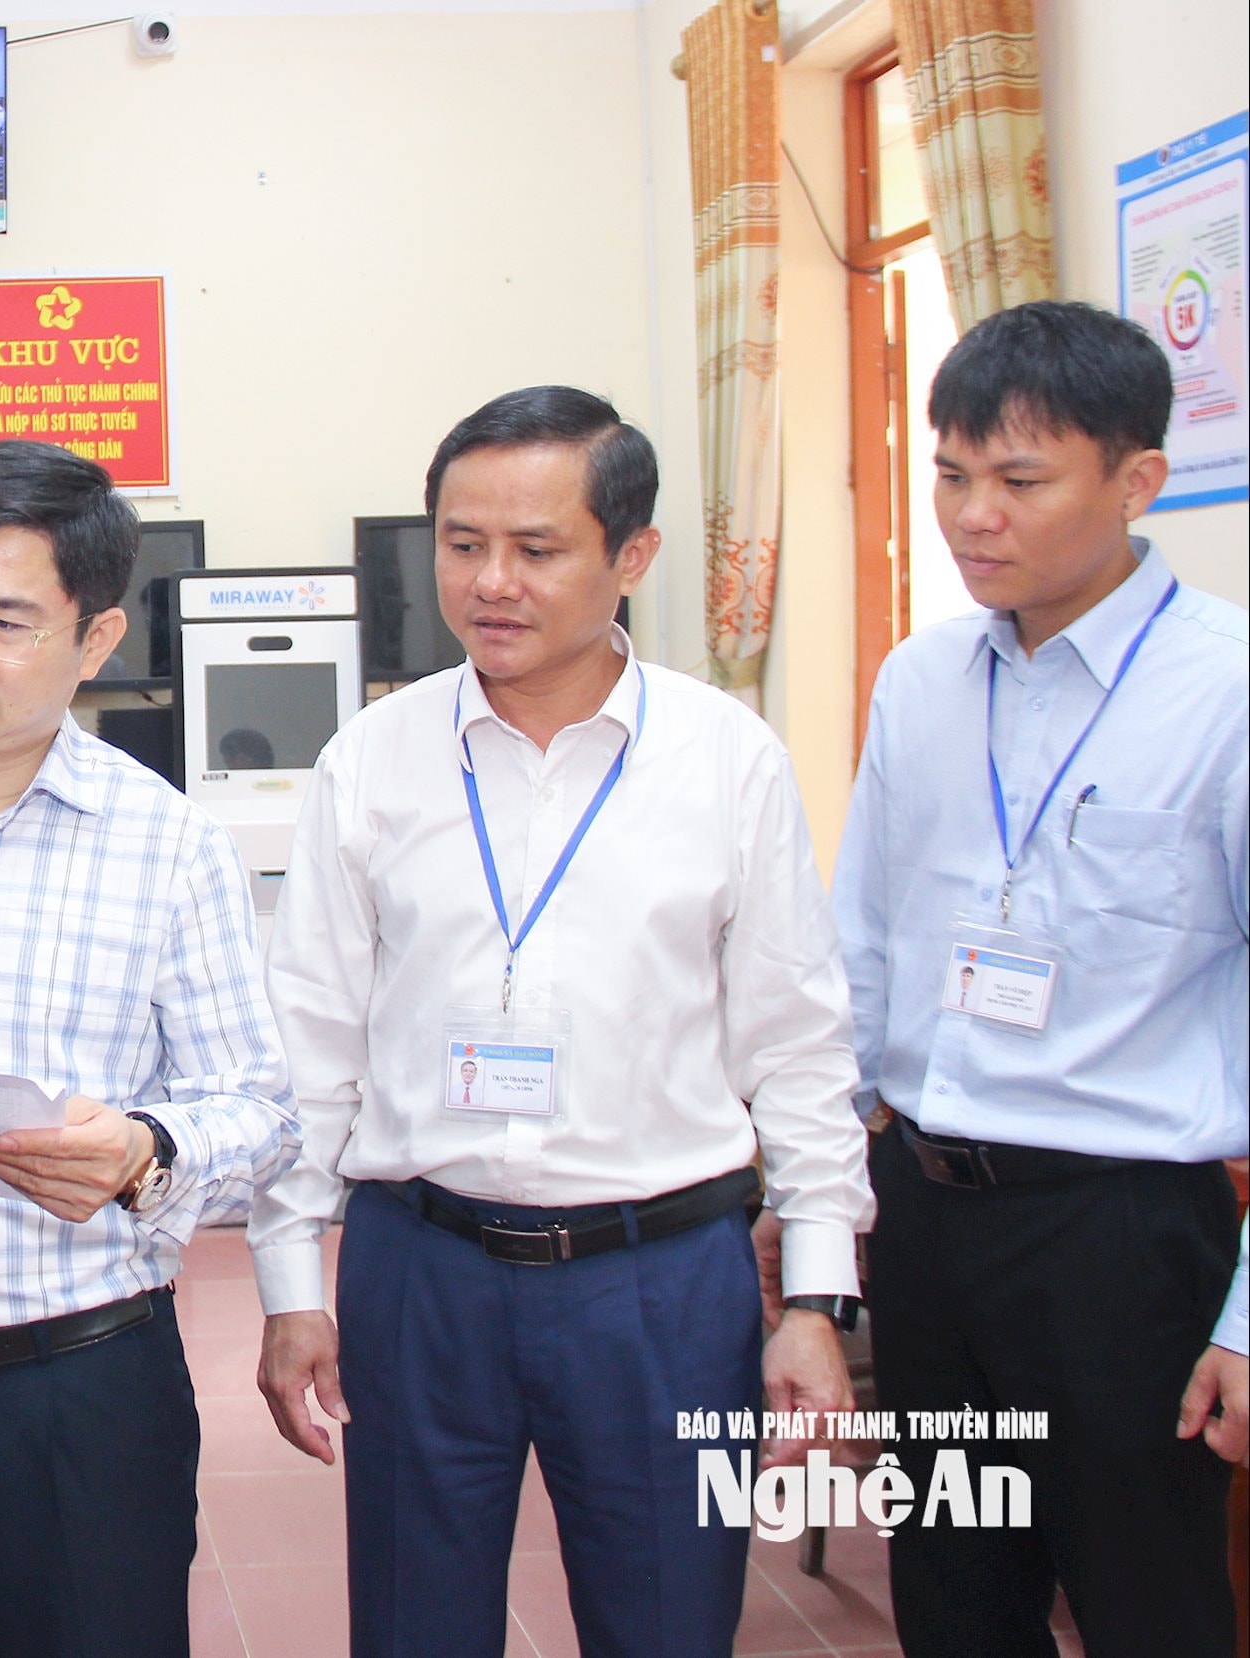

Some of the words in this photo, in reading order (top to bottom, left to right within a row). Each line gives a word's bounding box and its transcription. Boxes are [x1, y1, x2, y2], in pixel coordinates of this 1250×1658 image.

[69, 333, 140, 371] VỰC
[14, 381, 38, 404] CÁC
[40, 377, 62, 403] THỦ
[64, 383, 86, 406] TỤC
[88, 380, 120, 402] HÀNH
[122, 379, 158, 401] CHÍNH
[6, 411, 30, 436] NỘP
[50, 412, 67, 432] SƠ
[69, 411, 98, 434] TRỰC
[100, 406, 137, 431] TUYẾN
[97, 438, 123, 459] DÂN
[210, 590, 294, 605] MIRAWAY
